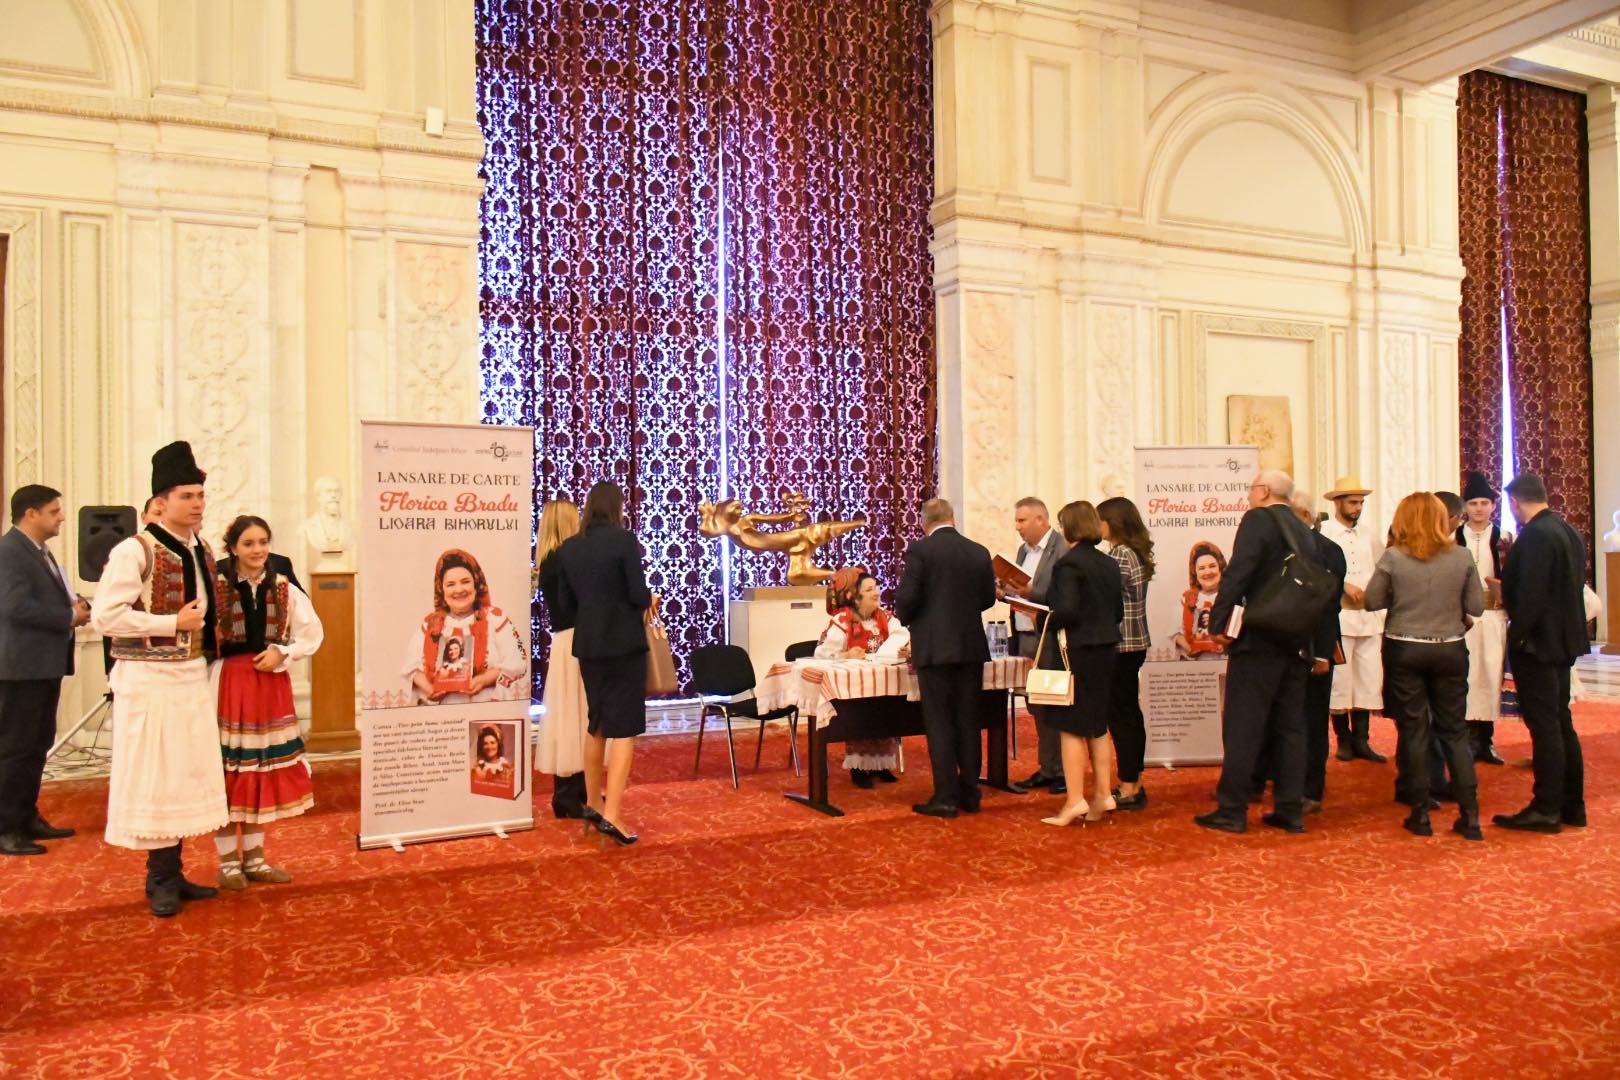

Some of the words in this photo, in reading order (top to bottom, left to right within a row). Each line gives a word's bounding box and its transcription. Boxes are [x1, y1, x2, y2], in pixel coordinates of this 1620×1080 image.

[378, 471, 447, 484] LANSARE
[450, 473, 470, 485] DE
[473, 473, 520, 486] CARTE
[1146, 483, 1196, 493] LANSARE
[1198, 483, 1212, 492] DE
[380, 491, 448, 512] Florica
[454, 492, 519, 513] Bradu
[1148, 498, 1197, 515] Florica
[379, 517, 436, 530] LIOARA
[1149, 517, 1189, 528] LIOARA
